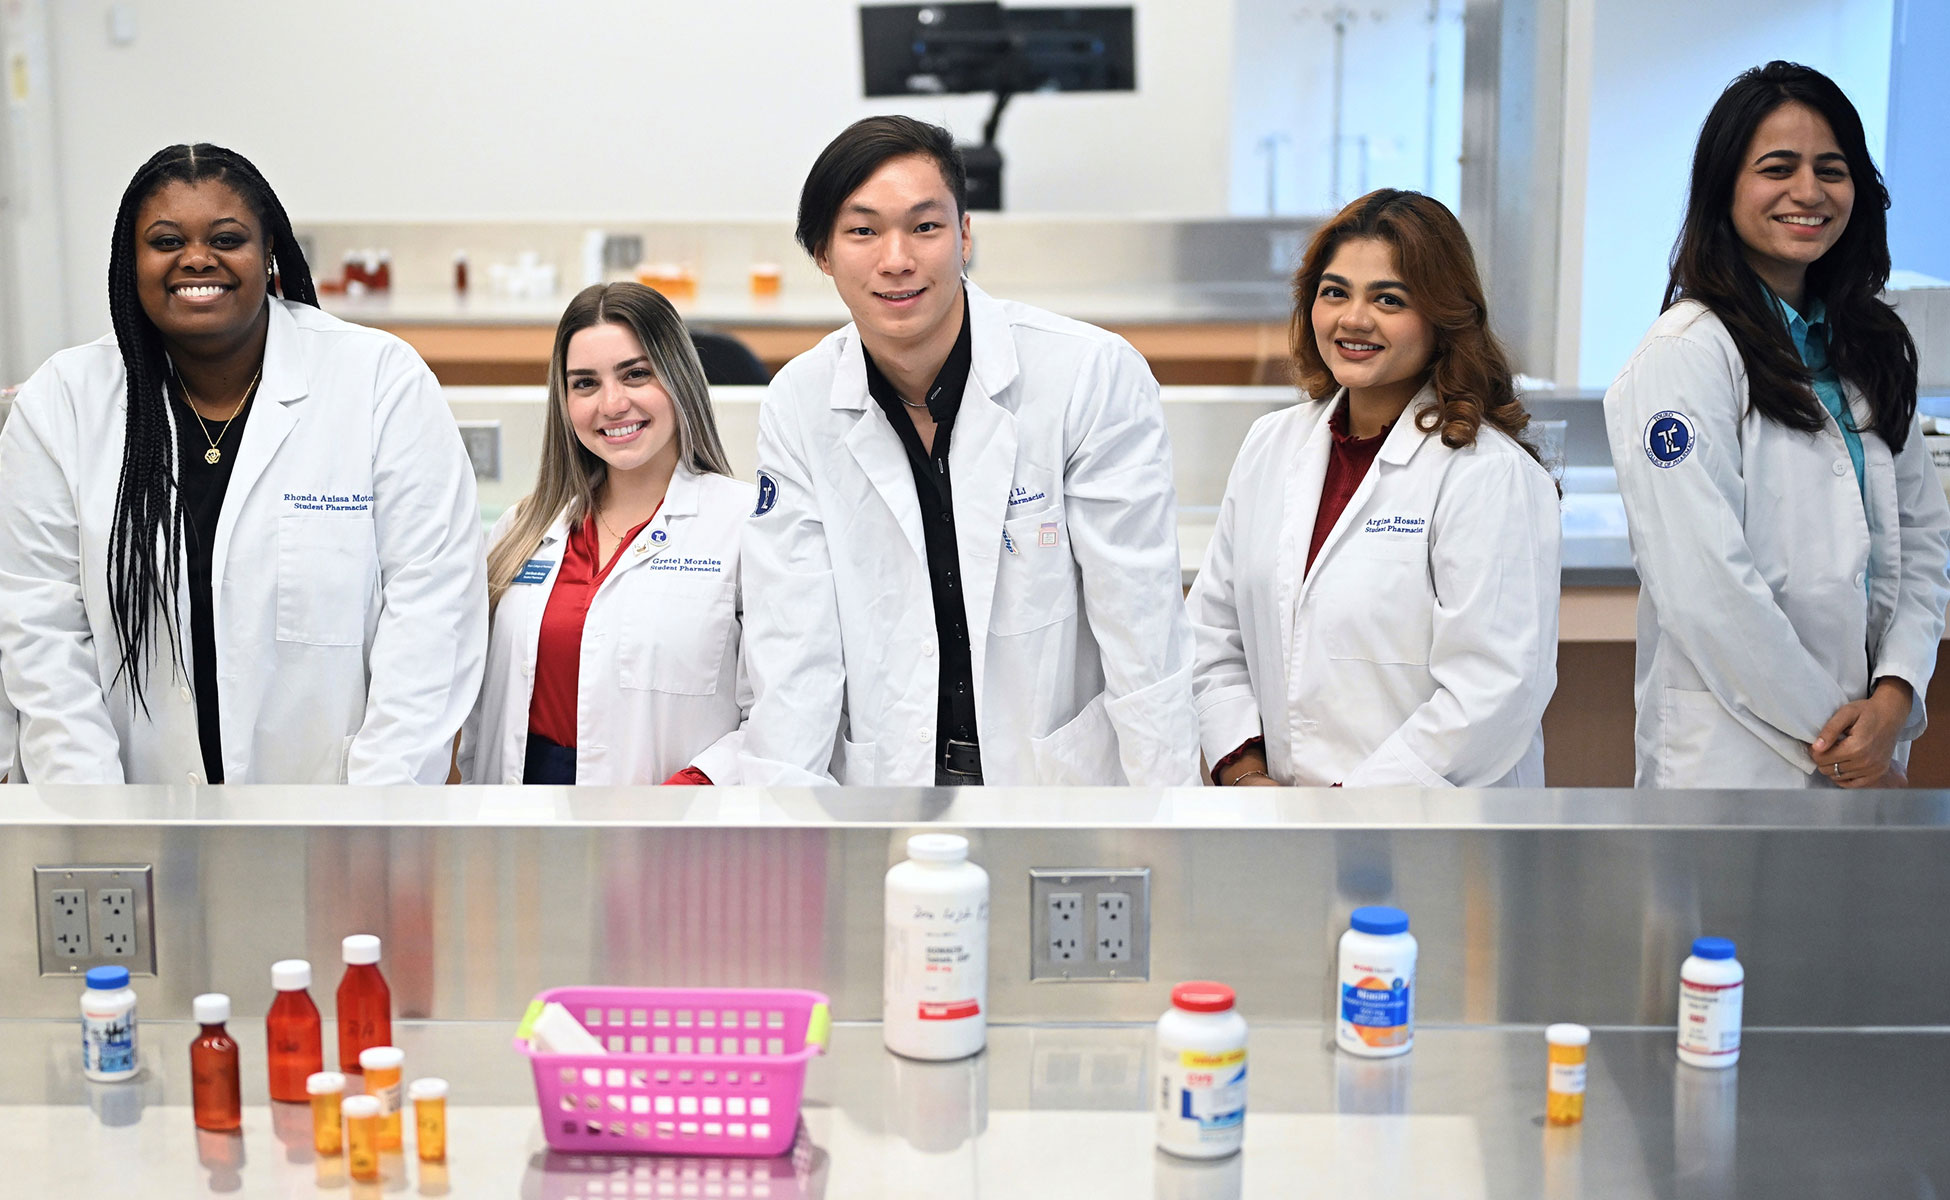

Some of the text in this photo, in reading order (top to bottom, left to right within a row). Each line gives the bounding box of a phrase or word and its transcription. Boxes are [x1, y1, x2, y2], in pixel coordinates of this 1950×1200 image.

[283, 493, 317, 502] Rhonda
[320, 495, 350, 503] Anissa
[1008, 492, 1046, 506] harmacist
[293, 502, 324, 511] Student
[1393, 516, 1426, 525] Hossain
[1387, 525, 1423, 534] Pharmacist
[684, 558, 722, 566] Morales
[679, 565, 721, 573] Pharmacist
